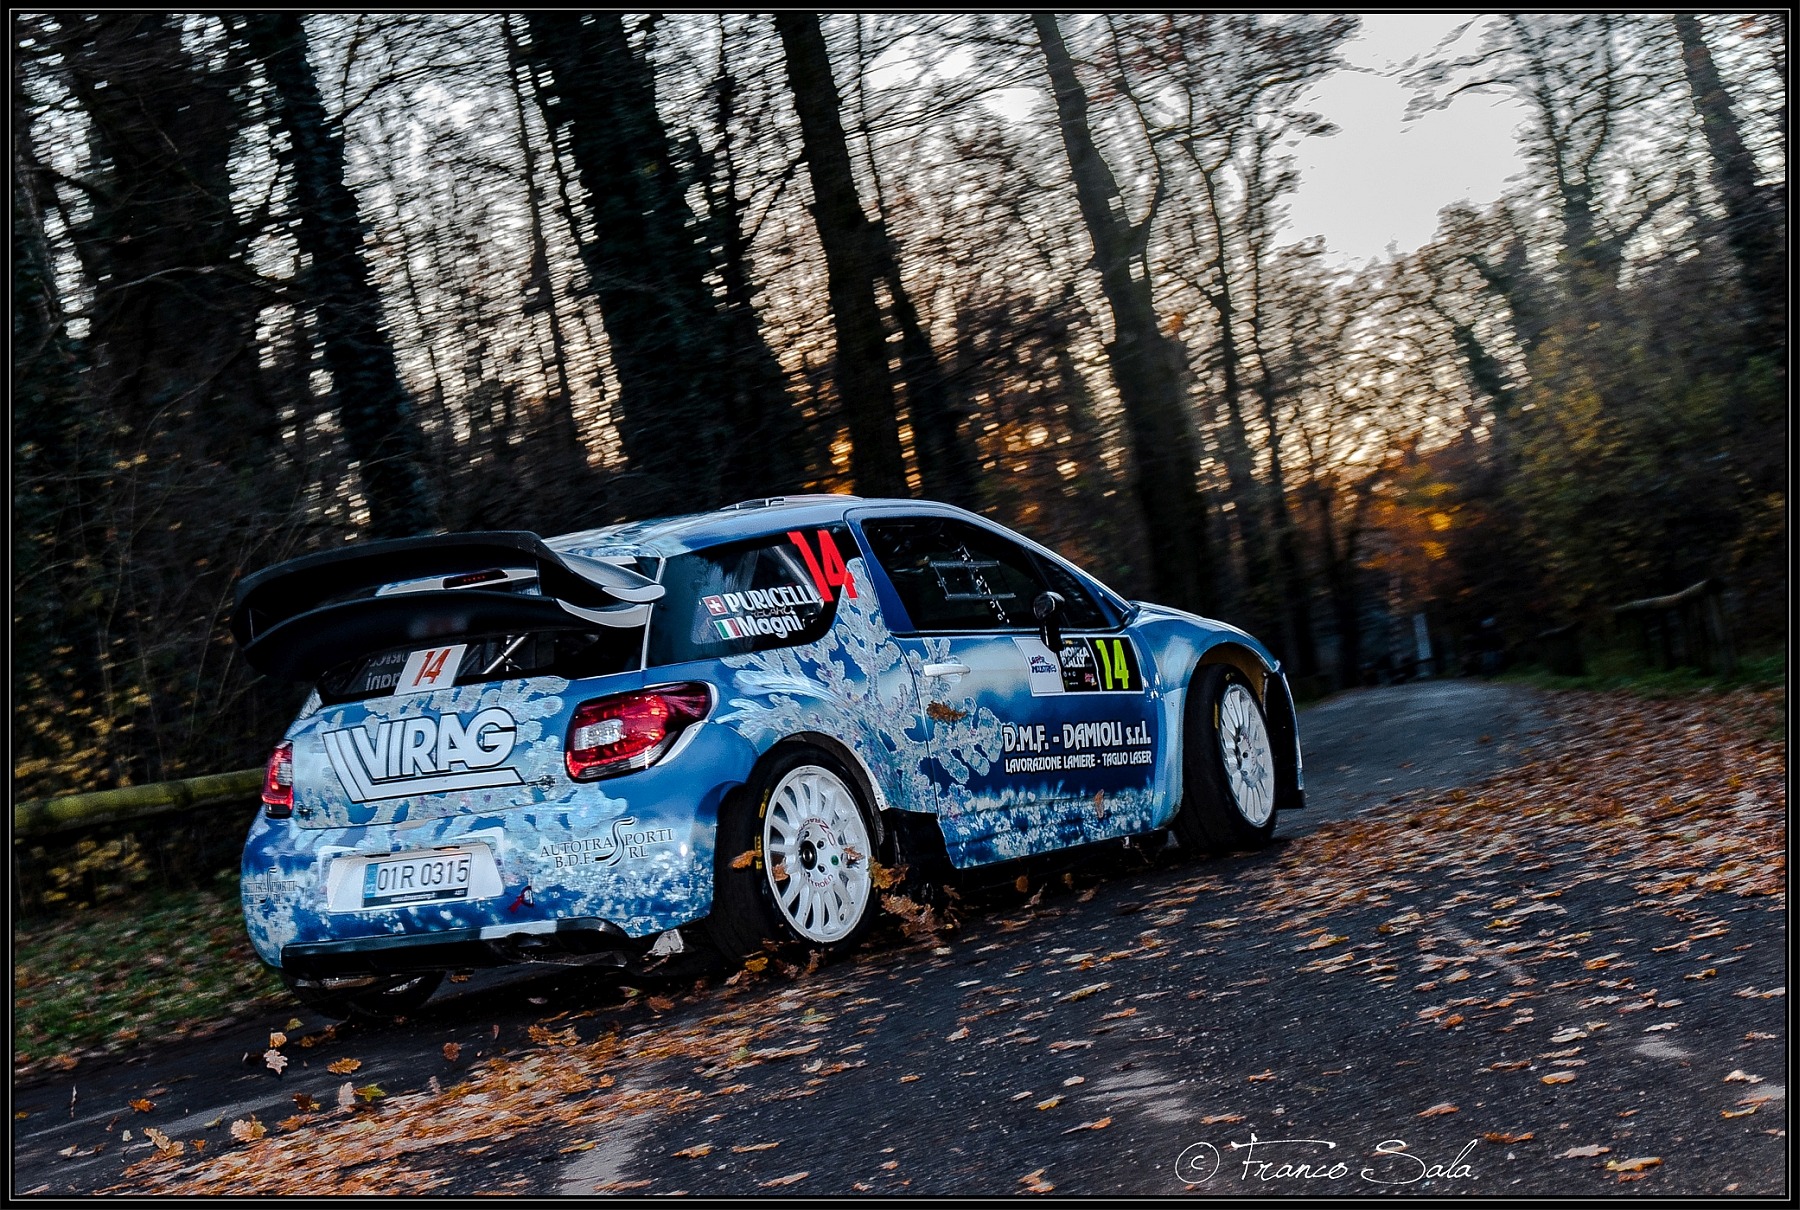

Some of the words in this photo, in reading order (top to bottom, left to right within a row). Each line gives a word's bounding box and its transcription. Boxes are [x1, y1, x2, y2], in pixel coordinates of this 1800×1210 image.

[787, 530, 858, 602] 14
[724, 585, 819, 613] PURICELLI
[736, 614, 803, 639] Magni
[412, 649, 451, 686] 14
[1095, 639, 1129, 689] 14
[351, 707, 517, 781] VIRAG
[1003, 725, 1049, 753] D.M.F.
[1063, 721, 1122, 750] DAMIOLI
[1126, 720, 1152, 745] s.r.l.
[1005, 756, 1062, 773] LAVORAZIONE
[1064, 754, 1096, 769] LAMIERE
[1102, 751, 1128, 766] TAGLIO
[1130, 750, 1152, 764] LASER
[378, 866, 414, 890] 01R
[421, 860, 470, 886] 0315
[555, 853, 595, 868] B.D.F.
